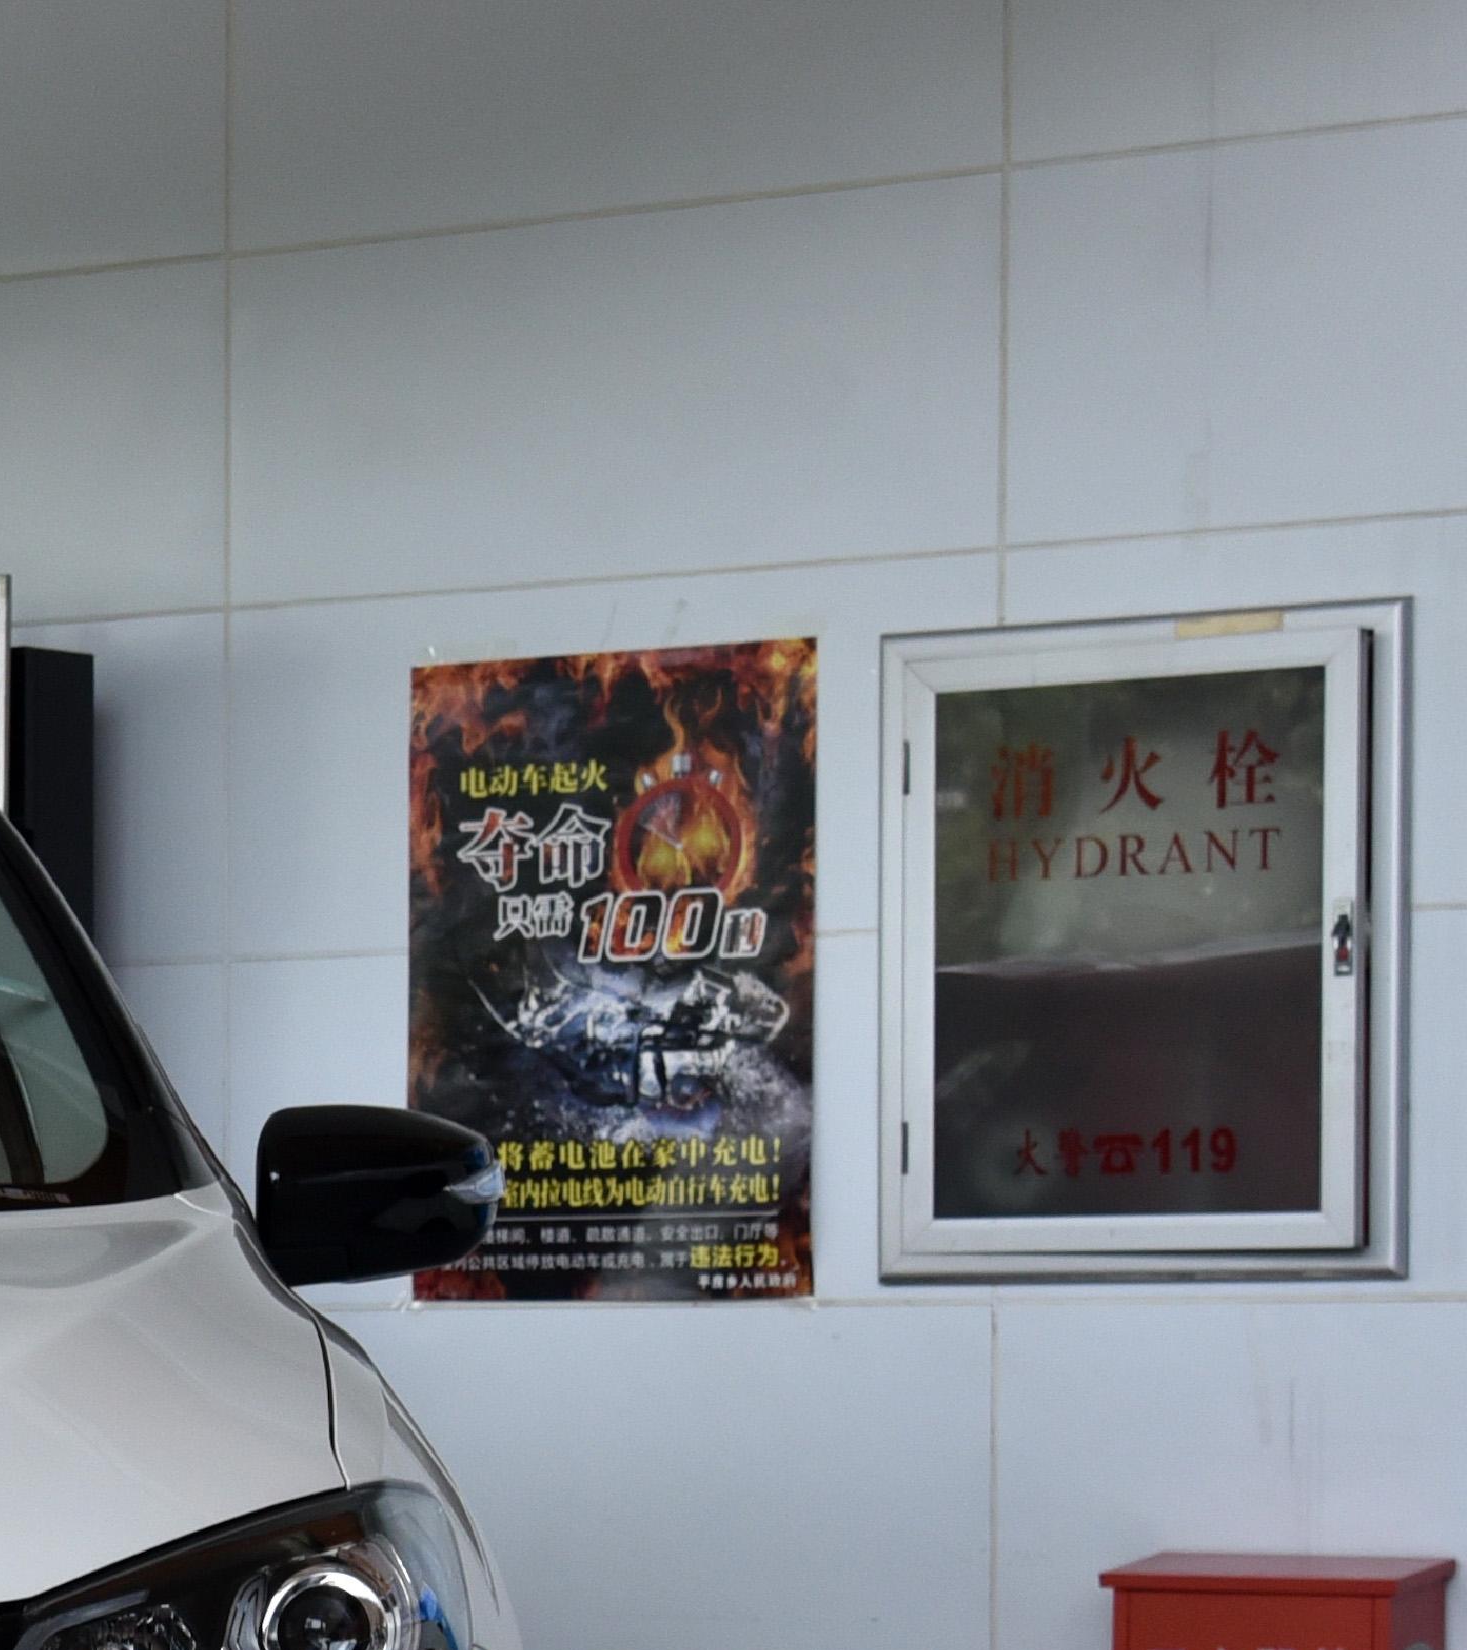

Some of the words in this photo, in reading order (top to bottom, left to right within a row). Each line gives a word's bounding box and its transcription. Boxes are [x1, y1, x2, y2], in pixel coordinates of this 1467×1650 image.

[459, 757, 608, 799] 电动车起火
[990, 729, 1281, 819] 消火栓
[457, 802, 613, 893] 夺命
[988, 827, 1283, 884] HYDRANT
[1152, 1125, 1238, 1174] 119
